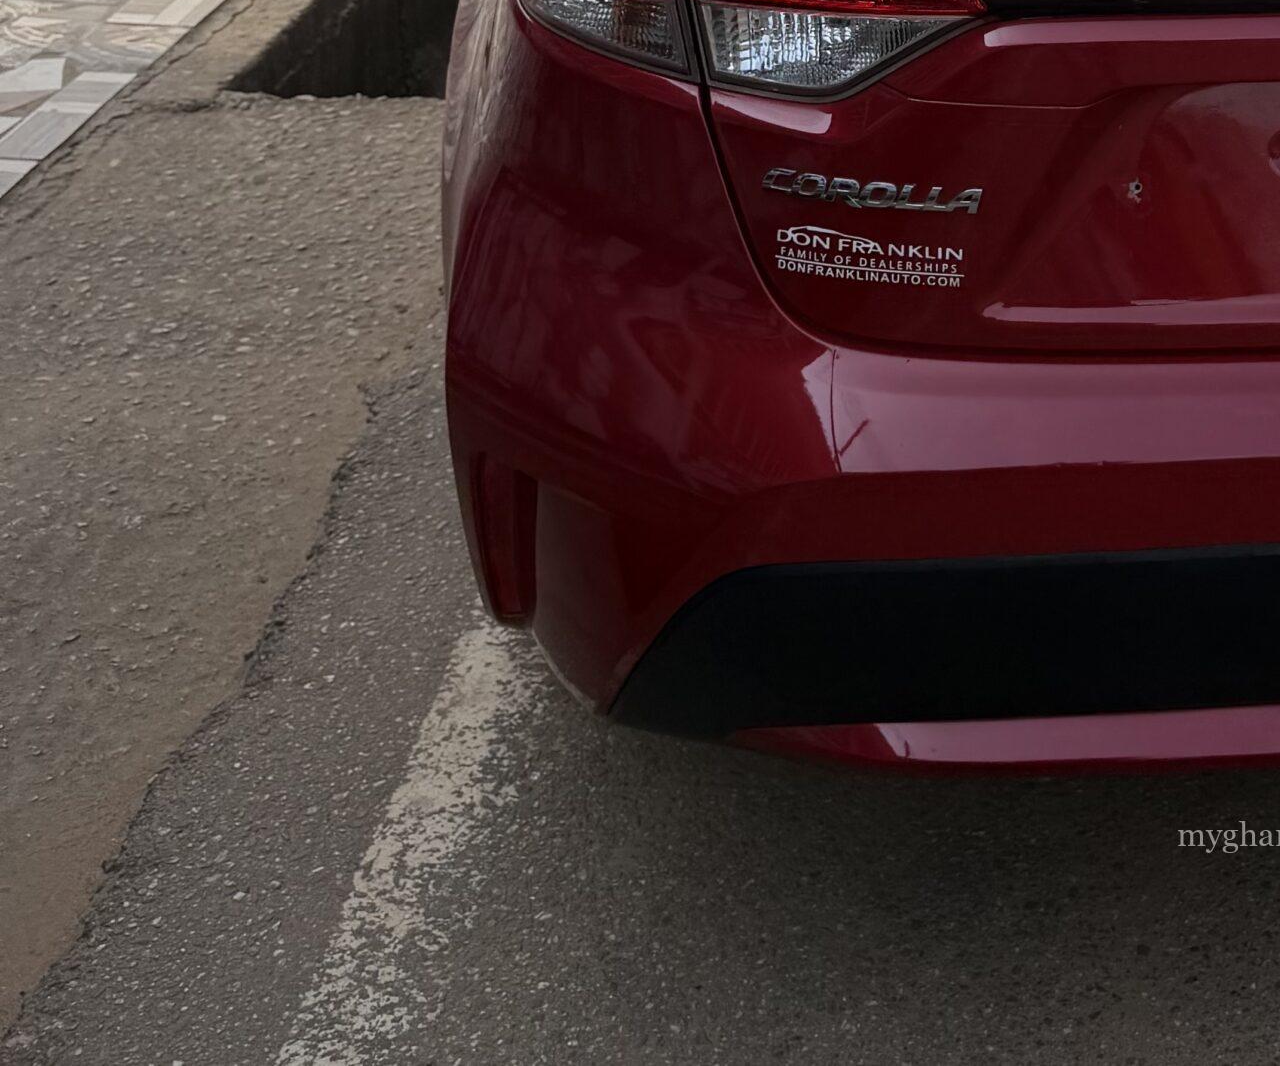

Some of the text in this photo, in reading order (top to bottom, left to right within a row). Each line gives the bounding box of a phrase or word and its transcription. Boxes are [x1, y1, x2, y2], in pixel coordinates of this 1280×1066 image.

[762, 168, 983, 214] COROLLA
[776, 228, 963, 261] DON FRANKLIN
[780, 246, 958, 274] FAMILY OF DEALERSHIPS
[777, 259, 961, 288] DONFRANKLINAUTO.COM
